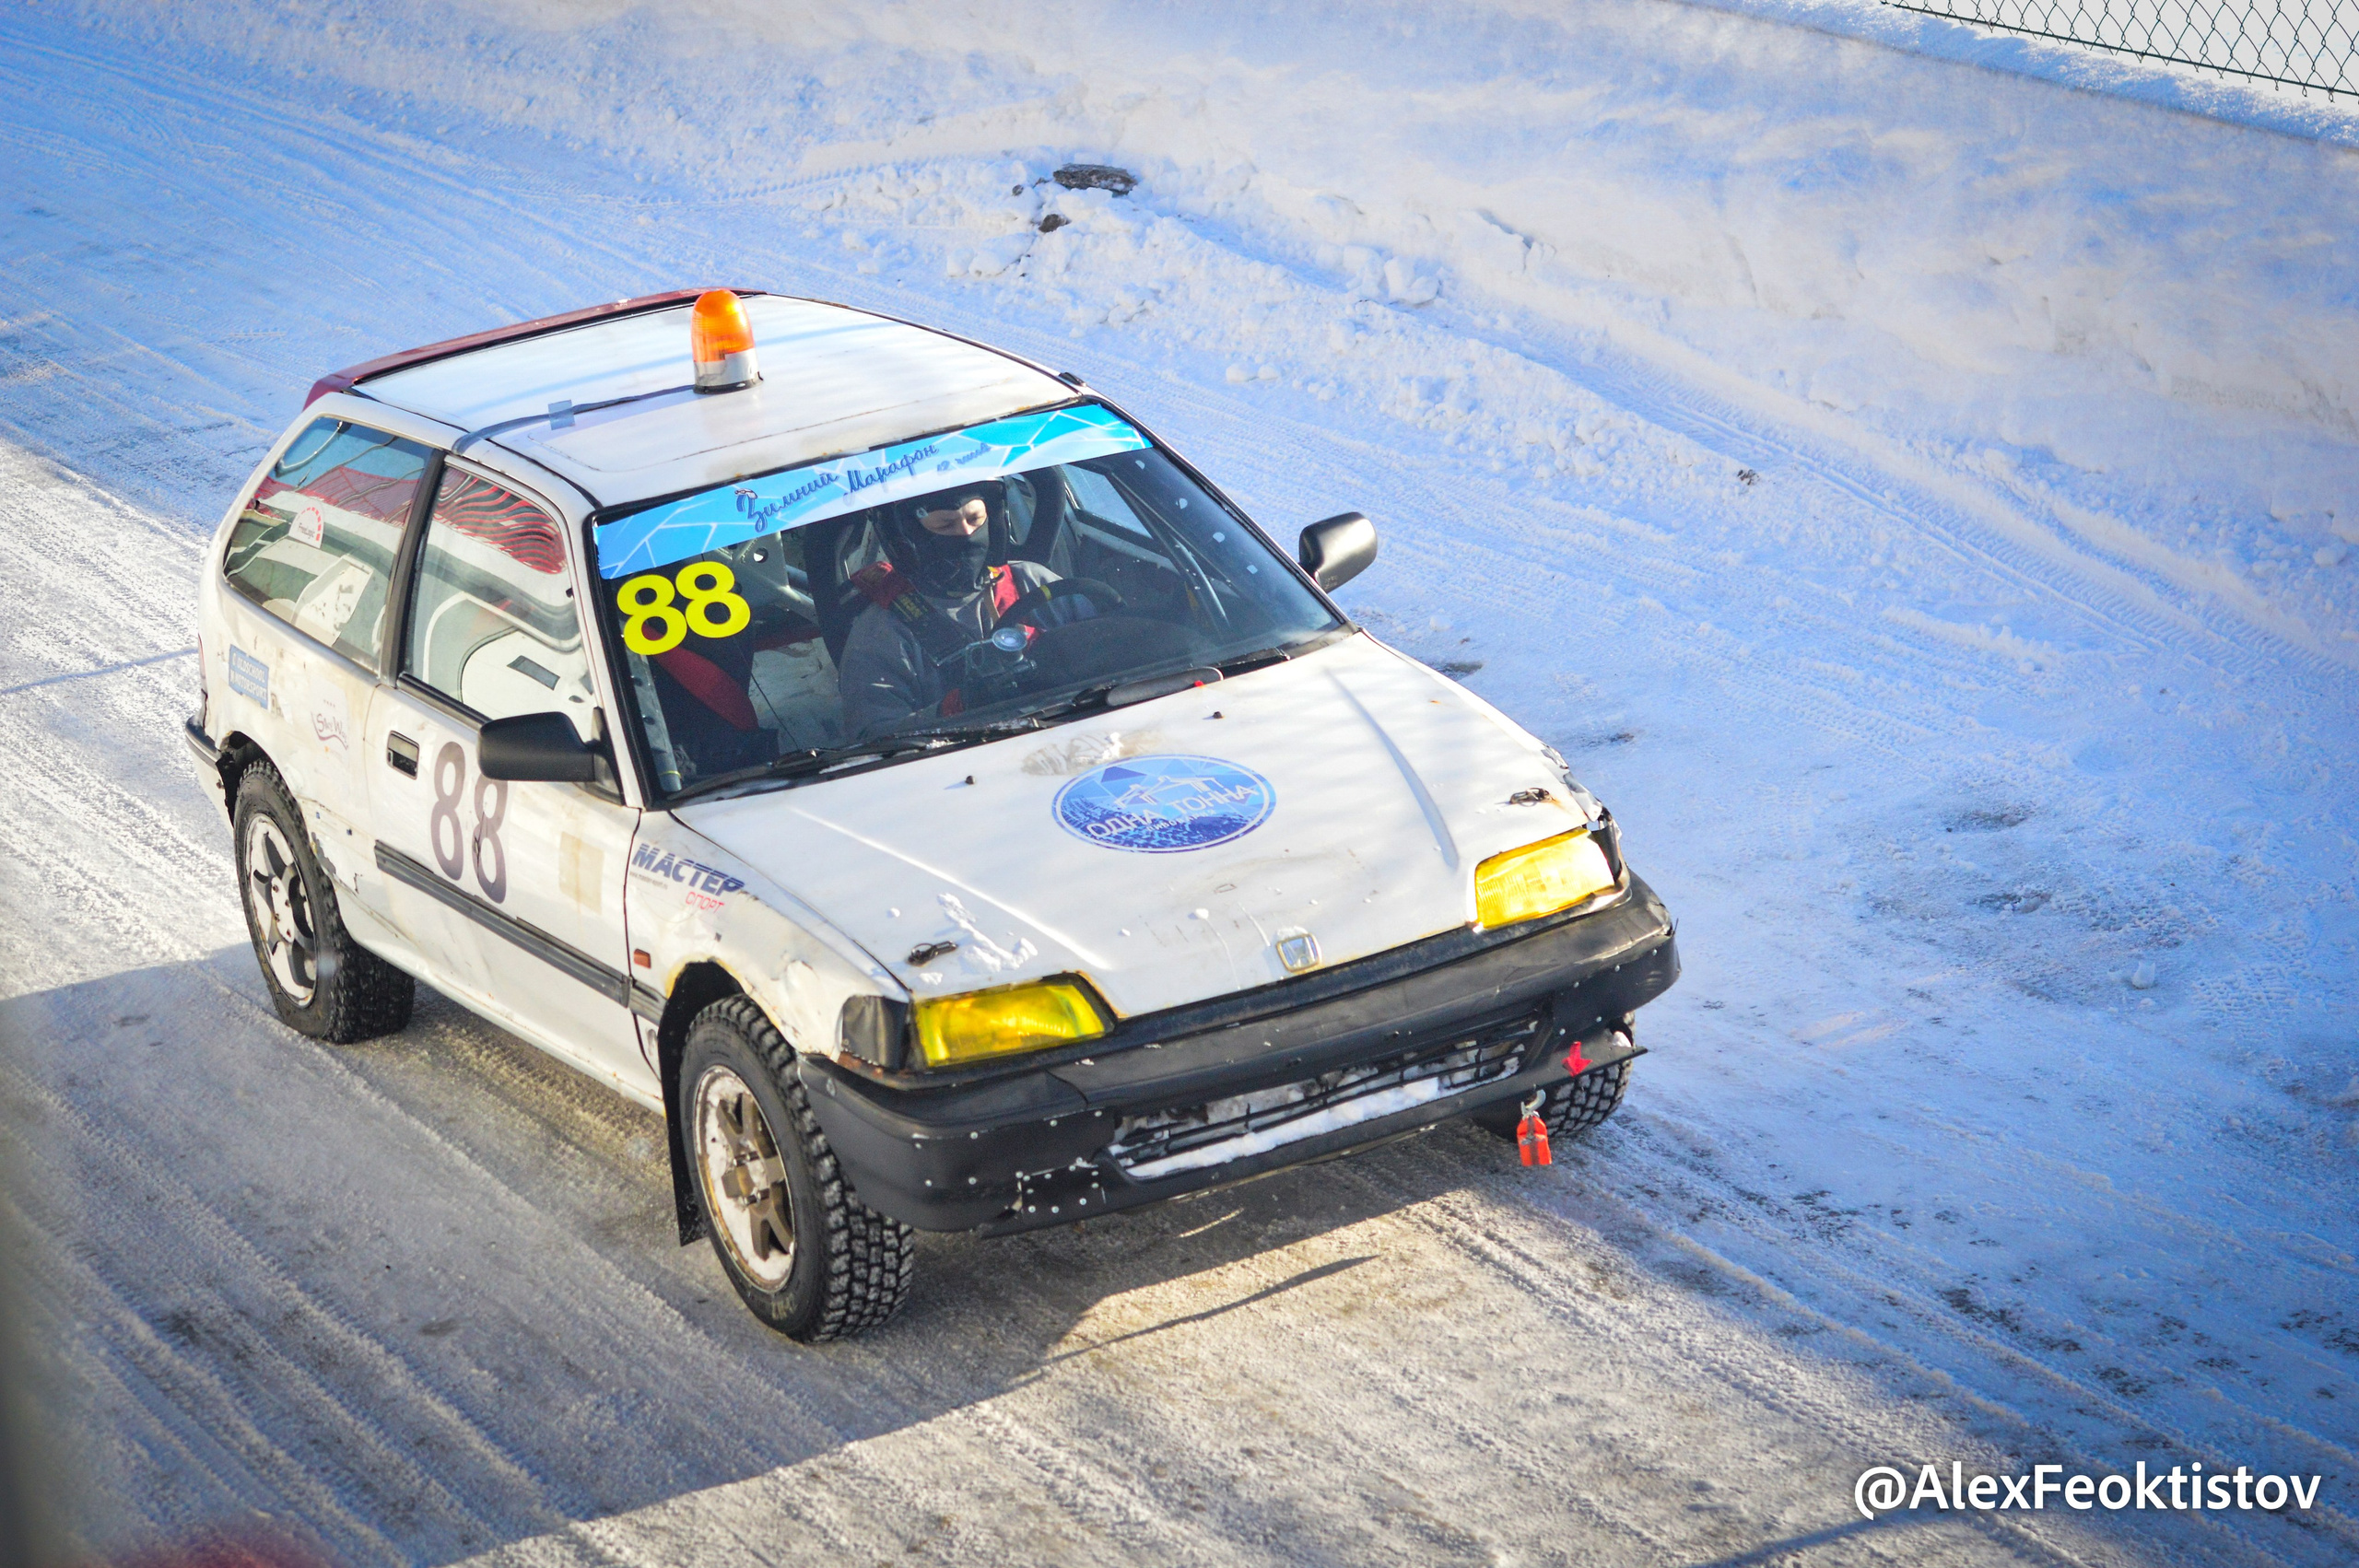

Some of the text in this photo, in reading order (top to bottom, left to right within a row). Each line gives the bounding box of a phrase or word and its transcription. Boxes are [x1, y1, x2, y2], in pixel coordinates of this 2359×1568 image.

[735, 444, 940, 533] Зимний Марафон
[616, 561, 751, 656] 88
[431, 741, 508, 904] 88
[1086, 783, 1260, 838] ОДНА ТОННА
[631, 842, 745, 896] МАСТЕР
[686, 891, 725, 914] СПОРТ
